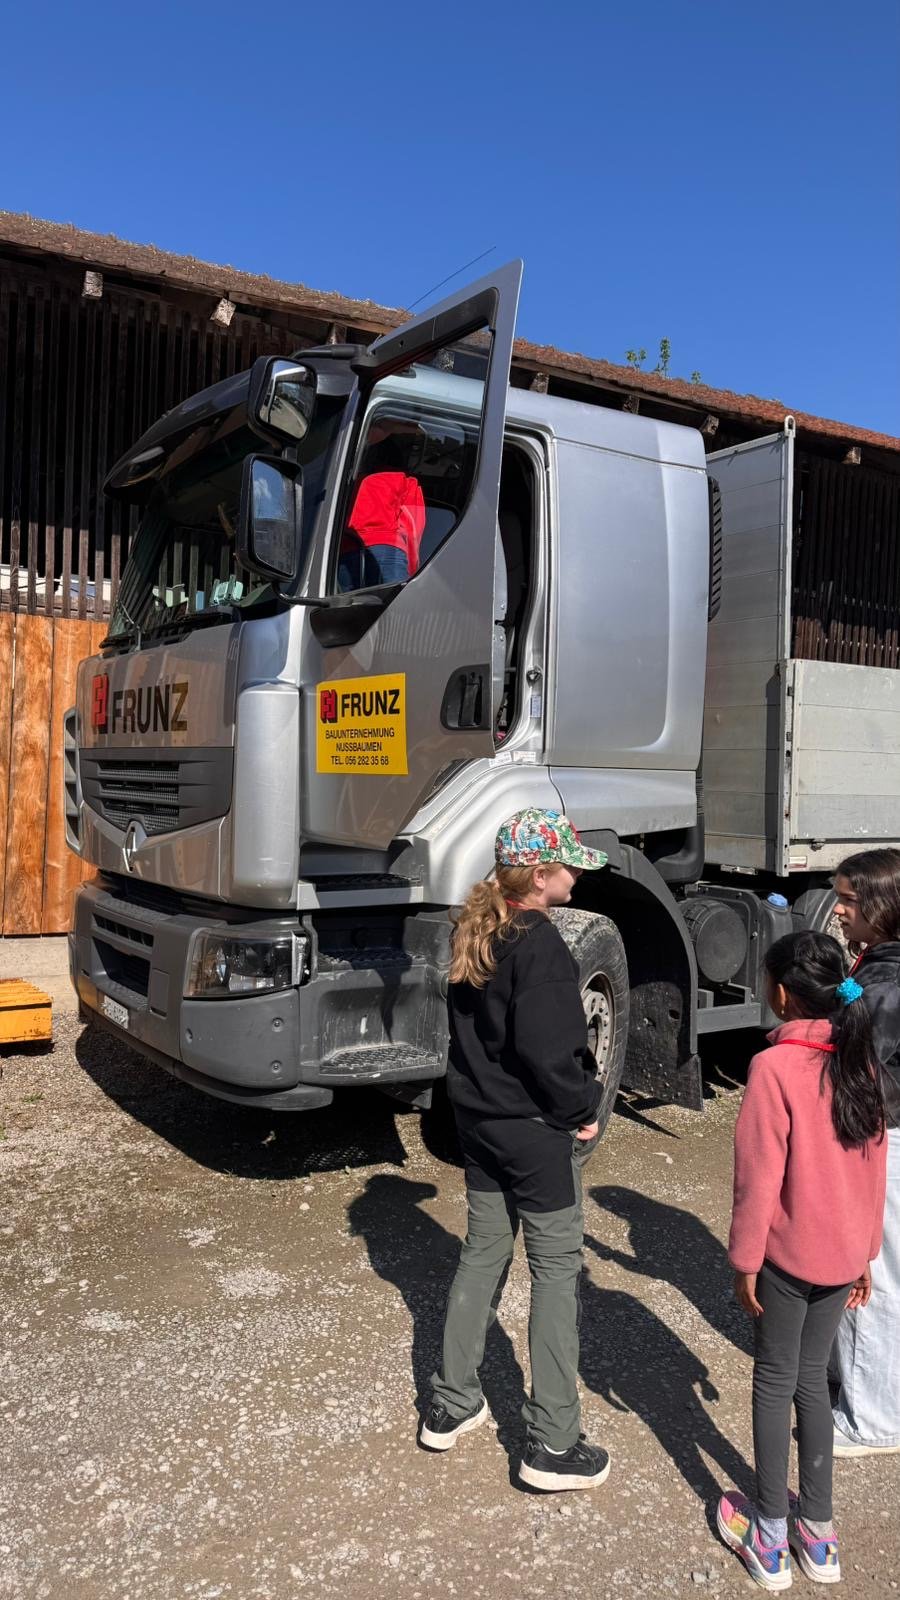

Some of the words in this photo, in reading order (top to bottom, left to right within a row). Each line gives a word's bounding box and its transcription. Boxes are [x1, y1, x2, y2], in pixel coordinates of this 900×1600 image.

[112, 682, 188, 734] FRUNZ
[341, 689, 400, 718] FRUNZ
[325, 727, 395, 739] BAUUNTERNEHMUNG
[335, 741, 382, 752] NUSSBAUMEN
[345, 756, 356, 765] 056
[357, 756, 369, 765] 282
[371, 756, 379, 765] 35
